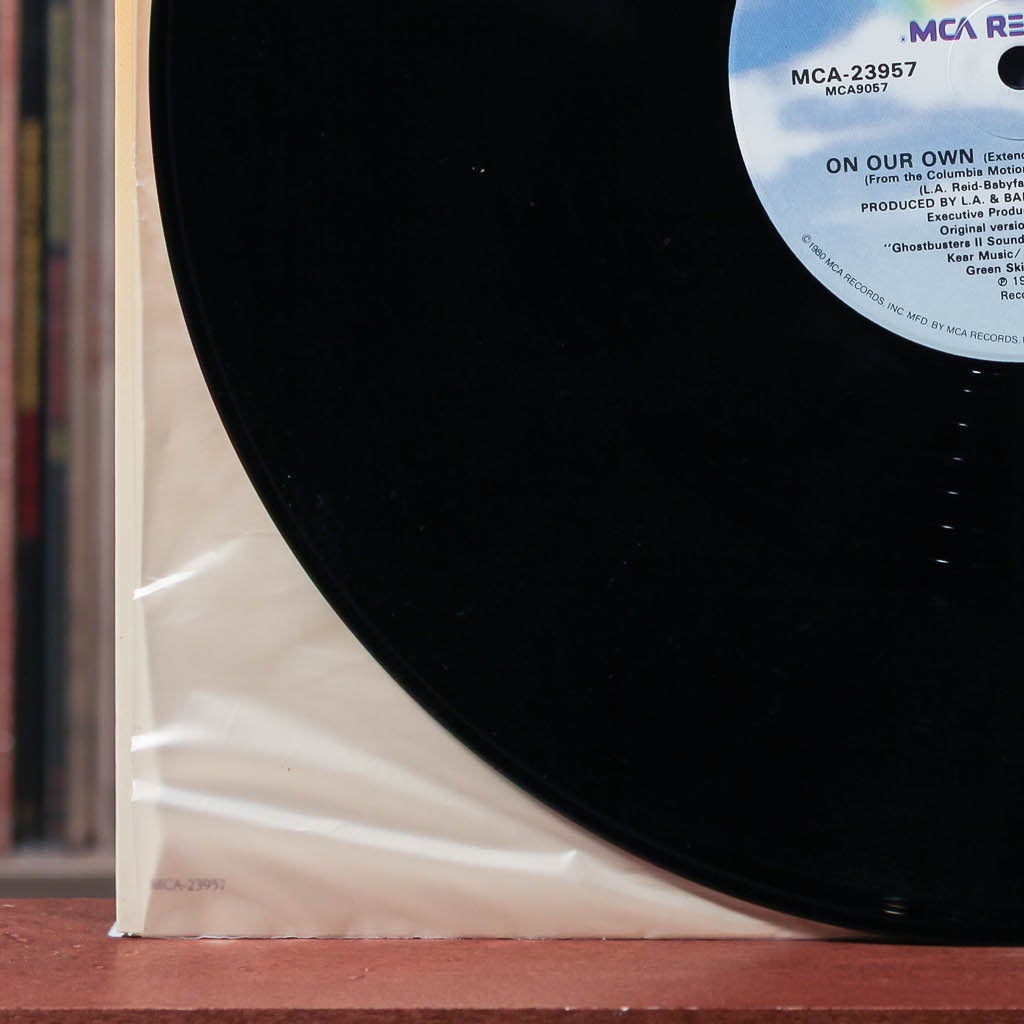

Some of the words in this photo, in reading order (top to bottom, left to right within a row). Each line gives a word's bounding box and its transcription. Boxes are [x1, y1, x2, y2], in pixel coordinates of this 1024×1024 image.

[909, 17, 978, 43] MCA
[791, 61, 918, 85] MCA-23957
[826, 156, 858, 174] ON
[866, 153, 913, 171] OUR
[922, 148, 974, 167] OWN
[864, 173, 899, 186] (From
[904, 172, 922, 182] the
[926, 168, 983, 181] Columbia
[919, 184, 947, 196] (L.A.
[861, 198, 935, 213] PRODUCED
[940, 197, 957, 208] BY
[961, 195, 985, 206] L.A.
[990, 194, 1000, 204] &
[927, 210, 984, 222] Executive
[940, 223, 986, 236] Original
[884, 240, 971, 253] "Ghostbusters
[975, 237, 982, 247] II
[947, 253, 974, 263] Kear
[978, 248, 1021, 261] Music/
[966, 264, 1001, 275] Green
[825, 258, 844, 277] MCA
[931, 320, 945, 331] BY
[946, 325, 968, 337] MCA
